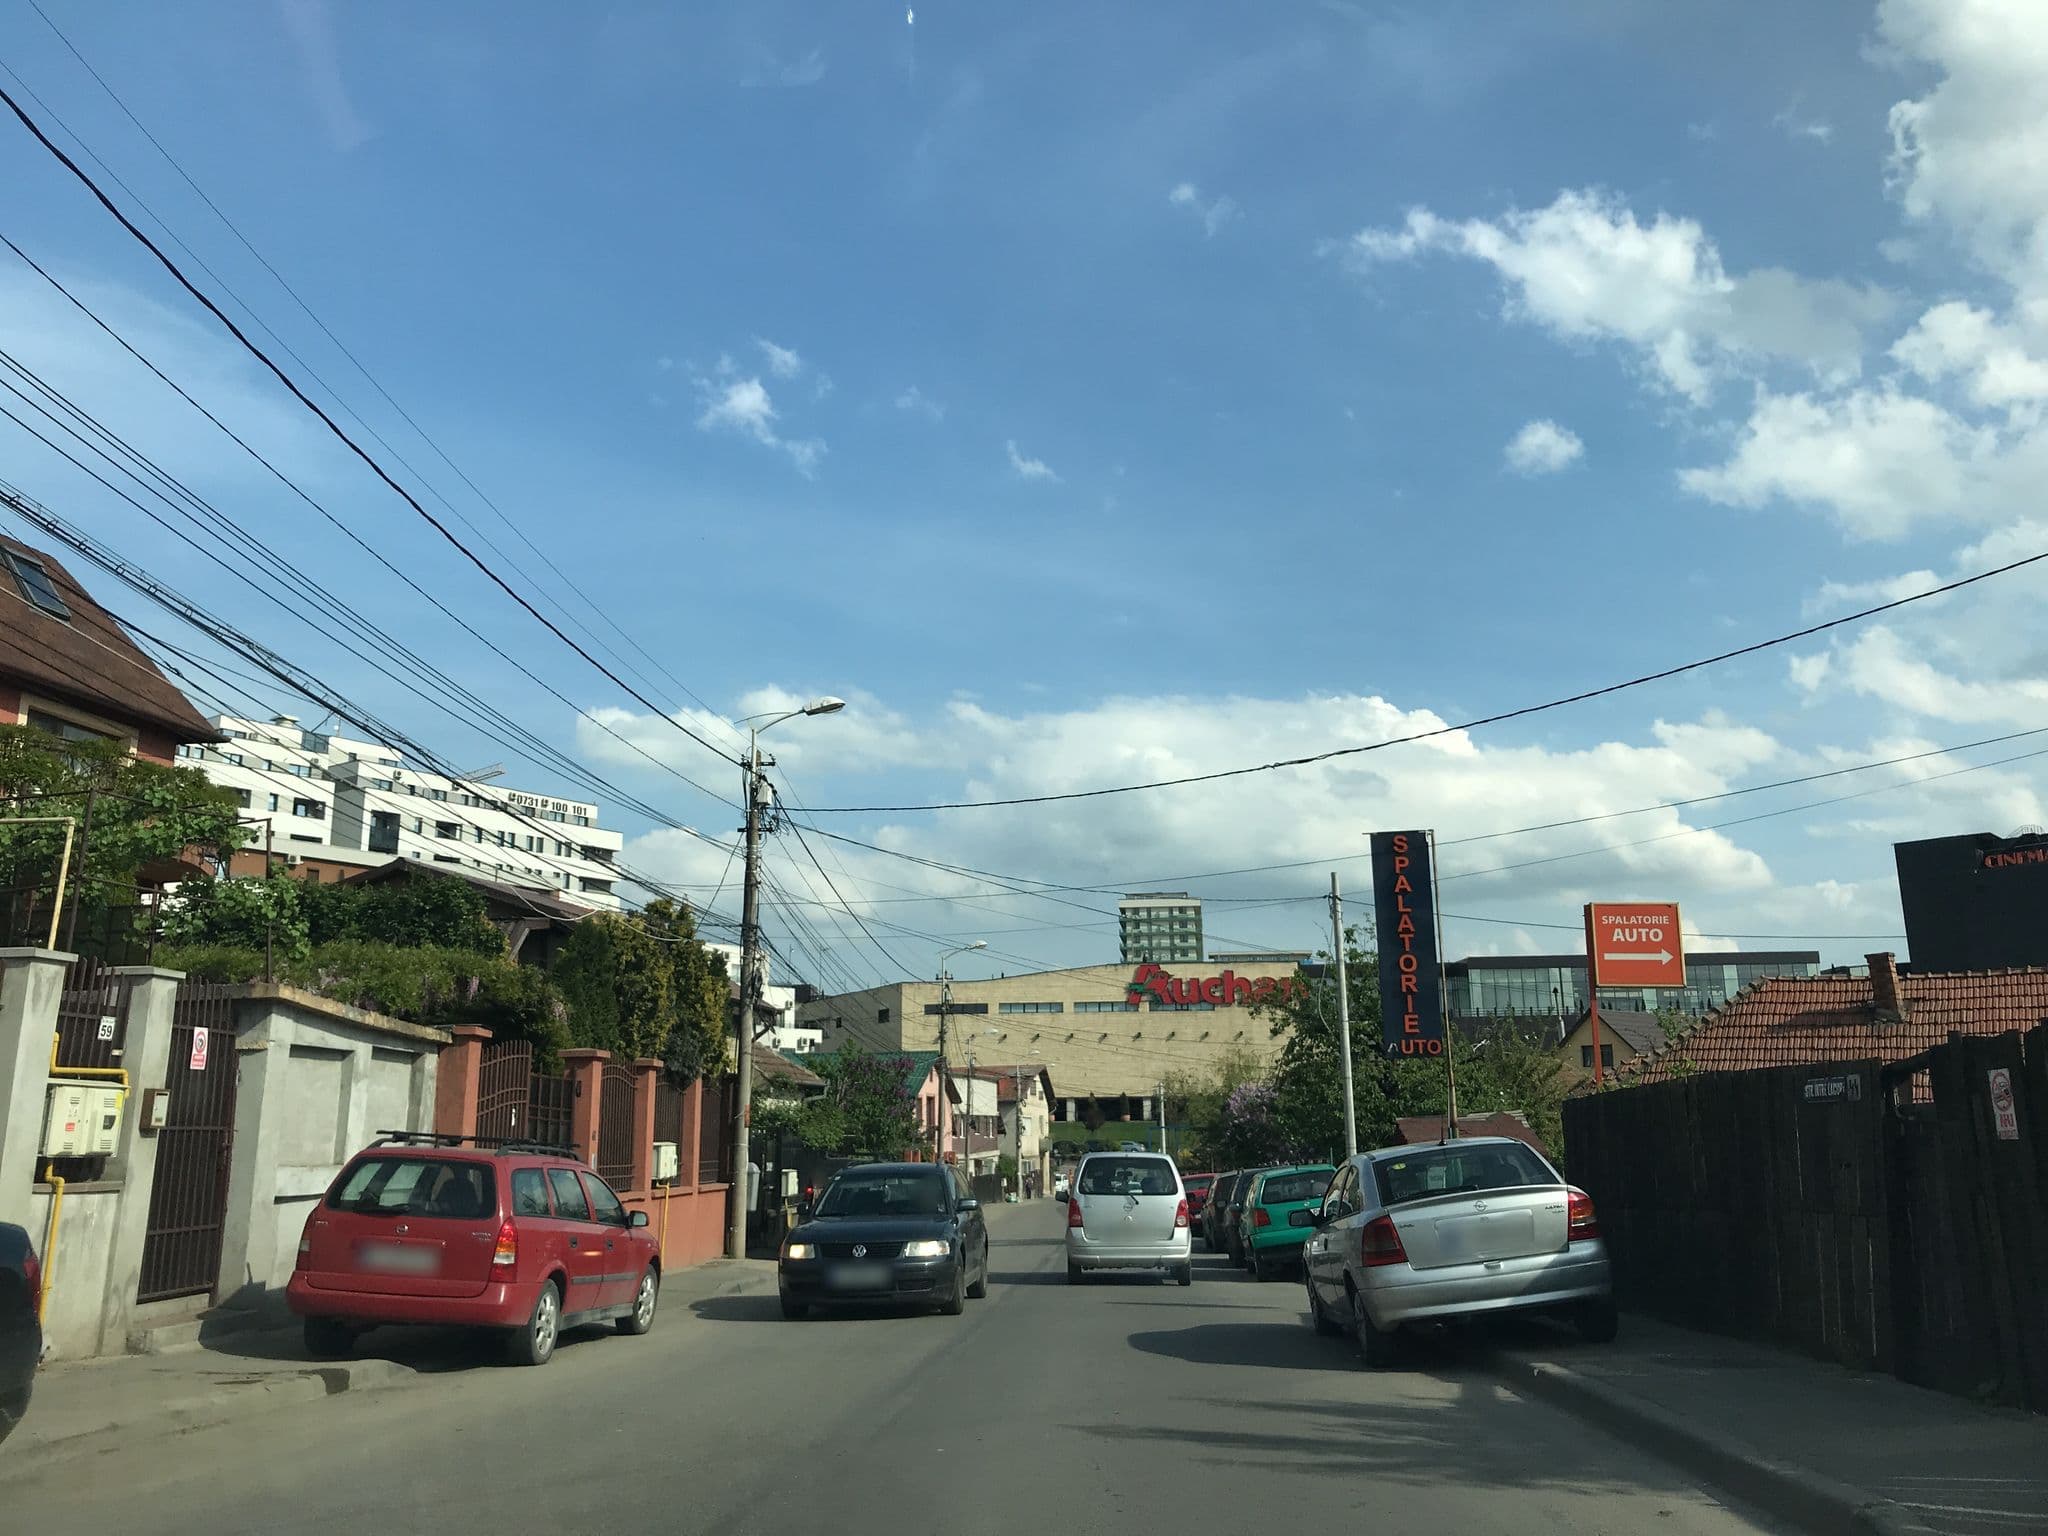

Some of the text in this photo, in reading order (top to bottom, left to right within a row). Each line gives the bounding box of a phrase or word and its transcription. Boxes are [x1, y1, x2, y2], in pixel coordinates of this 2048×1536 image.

[516, 795, 587, 816] 0731 100 101
[1601, 915, 1670, 925] SPALATORIE
[1393, 834, 1420, 1033] SPALATORIE
[1612, 927, 1664, 942] AUTO
[100, 1024, 113, 1038] 59
